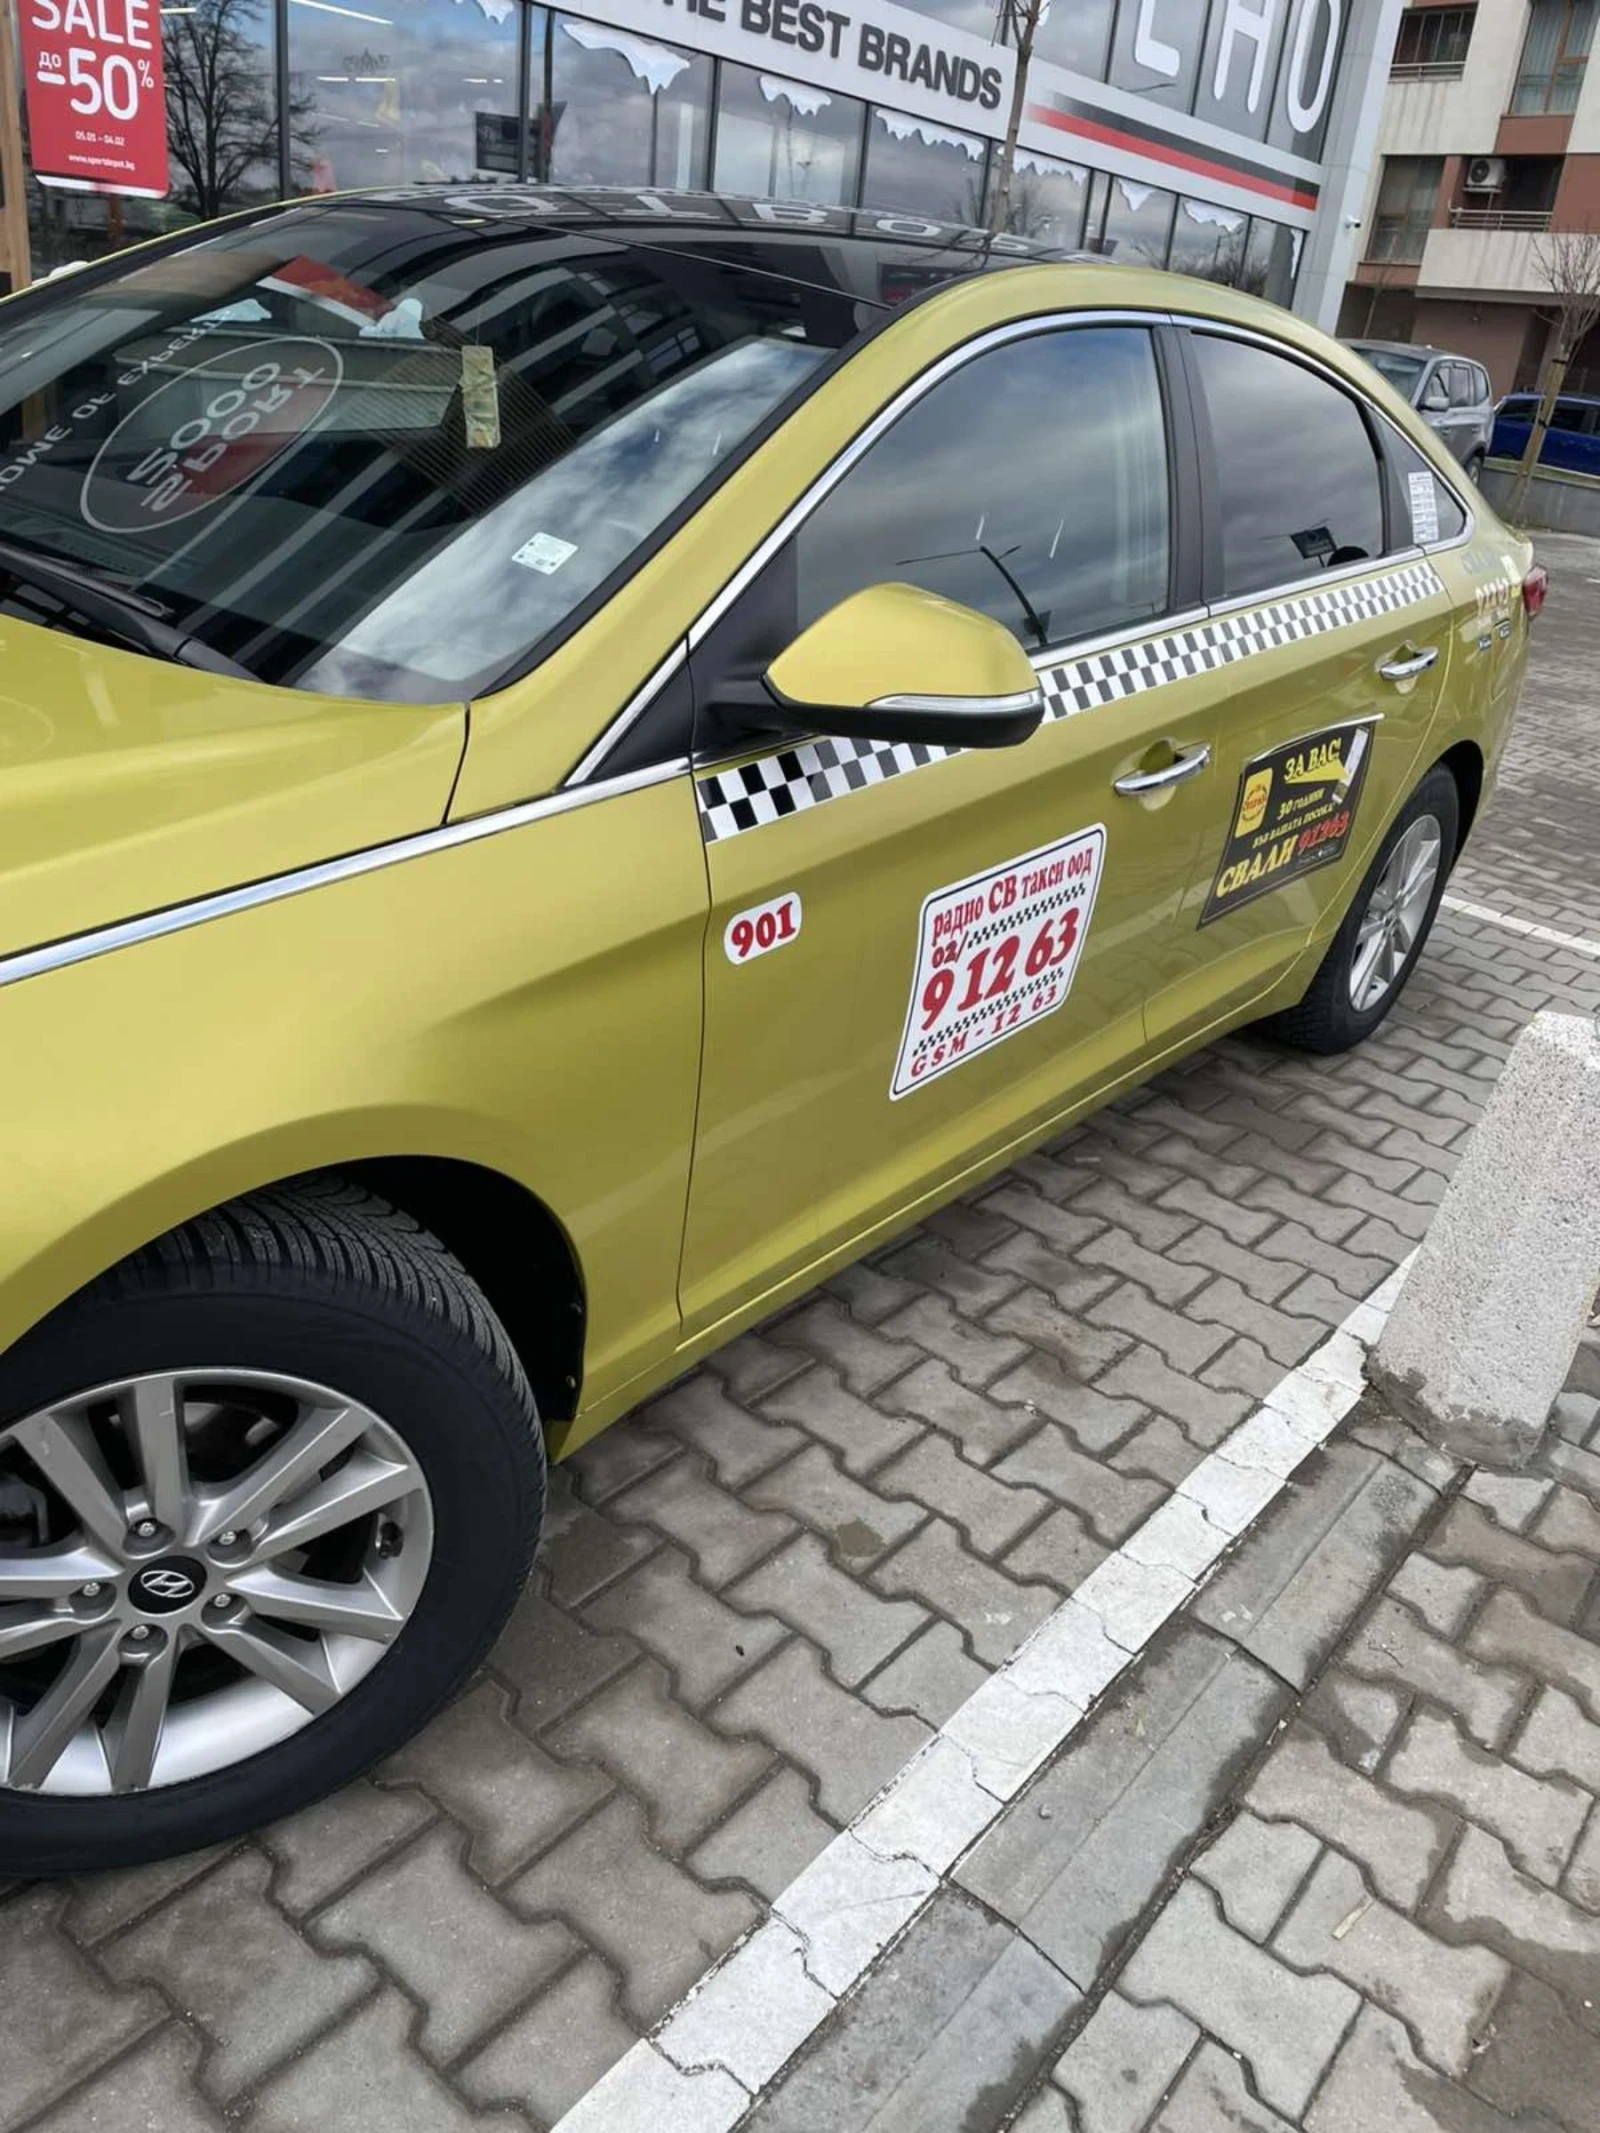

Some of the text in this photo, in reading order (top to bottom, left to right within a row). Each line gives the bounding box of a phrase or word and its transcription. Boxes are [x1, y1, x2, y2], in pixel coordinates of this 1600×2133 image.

[31, 0, 152, 50] SALE
[740, 0, 1003, 110] BEST BRANDS
[731, 900, 796, 957] 901
[931, 896, 984, 947] радио
[1021, 859, 1065, 899] такси
[1067, 848, 1094, 880] оод
